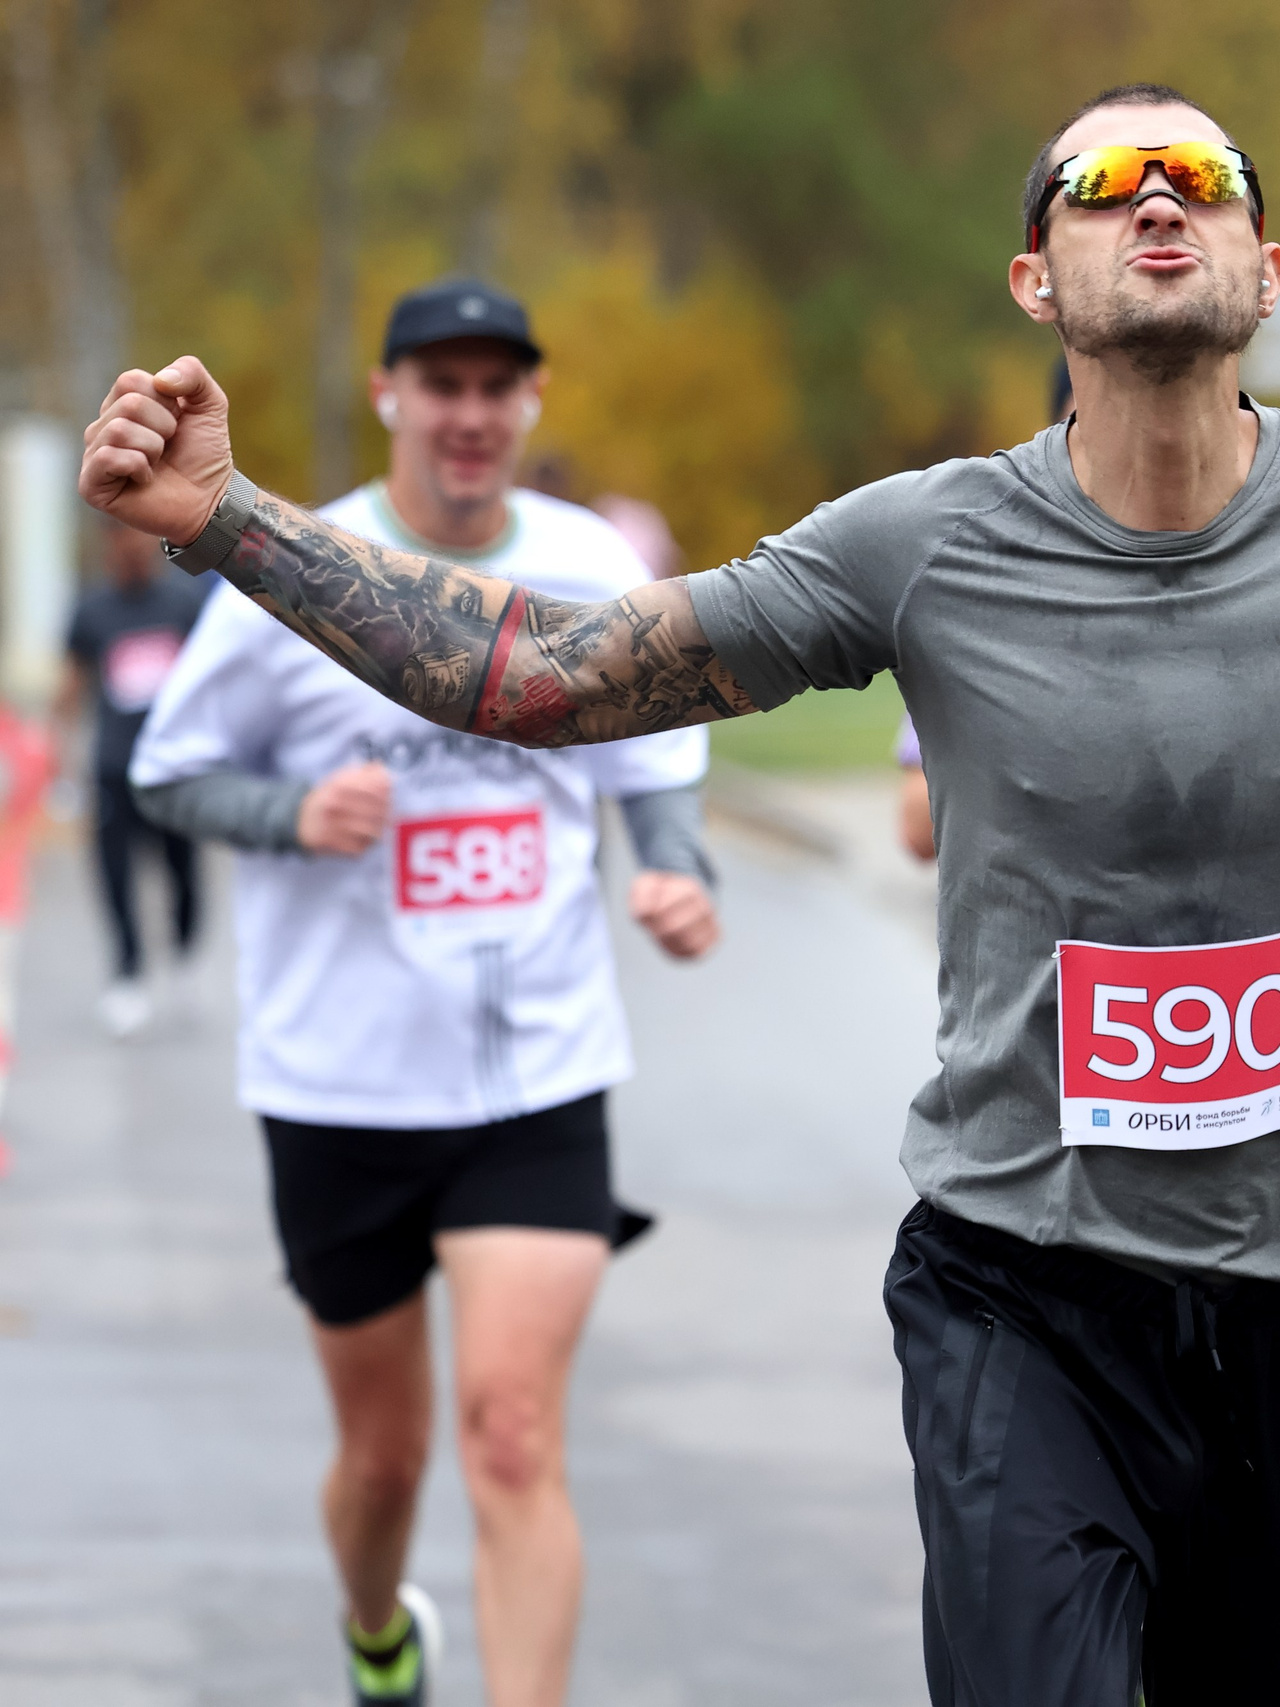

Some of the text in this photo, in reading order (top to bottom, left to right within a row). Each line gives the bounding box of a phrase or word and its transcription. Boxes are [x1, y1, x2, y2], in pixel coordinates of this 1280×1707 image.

[1220, 1106, 1251, 1118] борьбы
[1128, 1112, 1191, 1131] ОРБИ
[1203, 1116, 1246, 1129] инсультом
